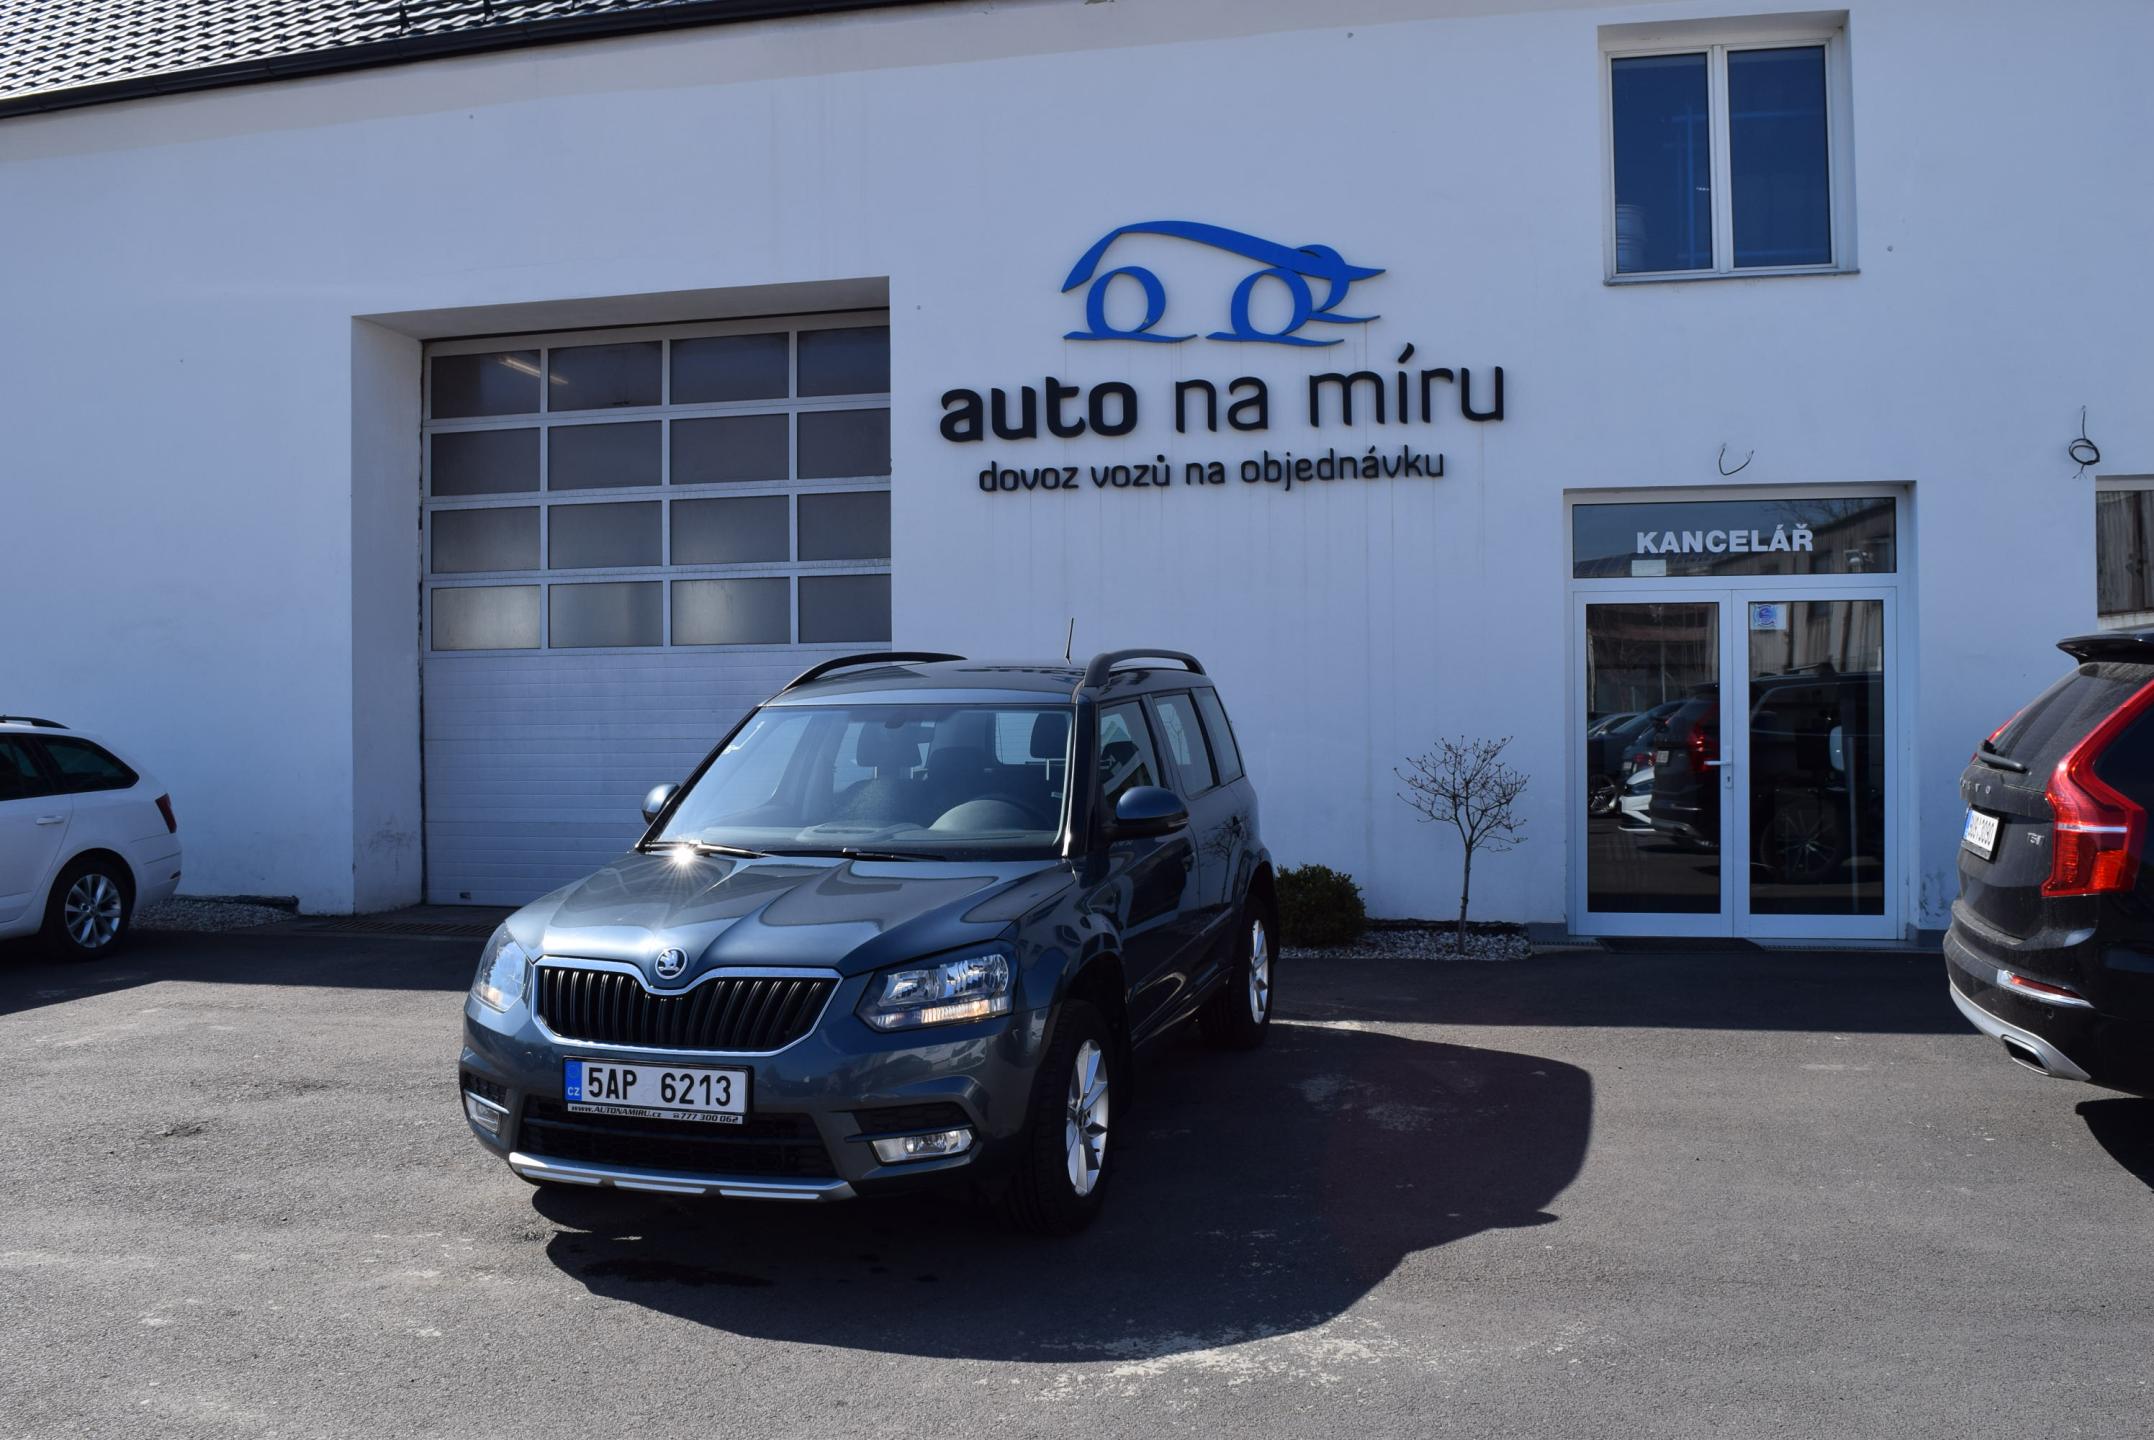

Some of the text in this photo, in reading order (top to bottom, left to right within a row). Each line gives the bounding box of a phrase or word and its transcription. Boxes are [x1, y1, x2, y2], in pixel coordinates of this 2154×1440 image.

[939, 342, 1505, 442] auto na míru
[978, 445, 1445, 492] dovoz vozů na objednávku
[1636, 523, 1814, 554] KANCELÁŘ
[567, 1087, 581, 1097] CZ
[588, 1067, 732, 1107] 5AP 6213
